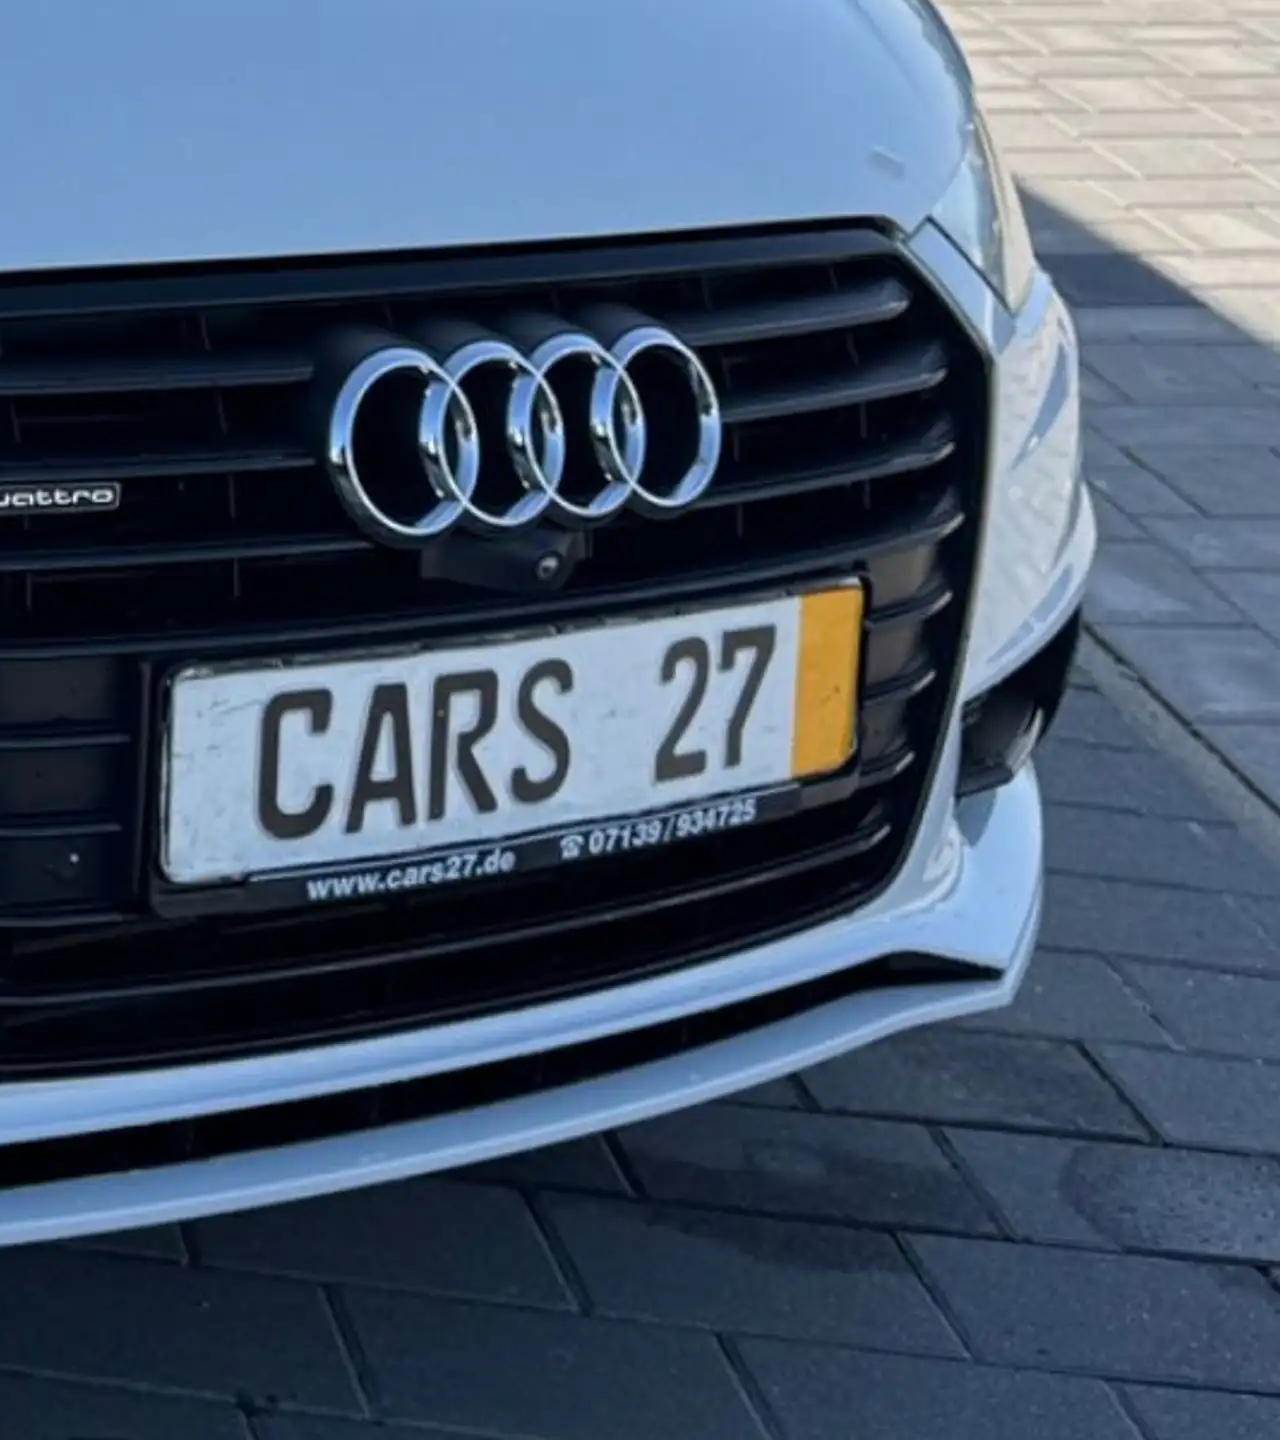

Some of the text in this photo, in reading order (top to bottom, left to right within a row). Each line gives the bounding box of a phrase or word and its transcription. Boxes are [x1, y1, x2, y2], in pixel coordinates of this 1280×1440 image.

[256, 624, 777, 840] CARS 27
[306, 849, 516, 901] www.cars27.de
